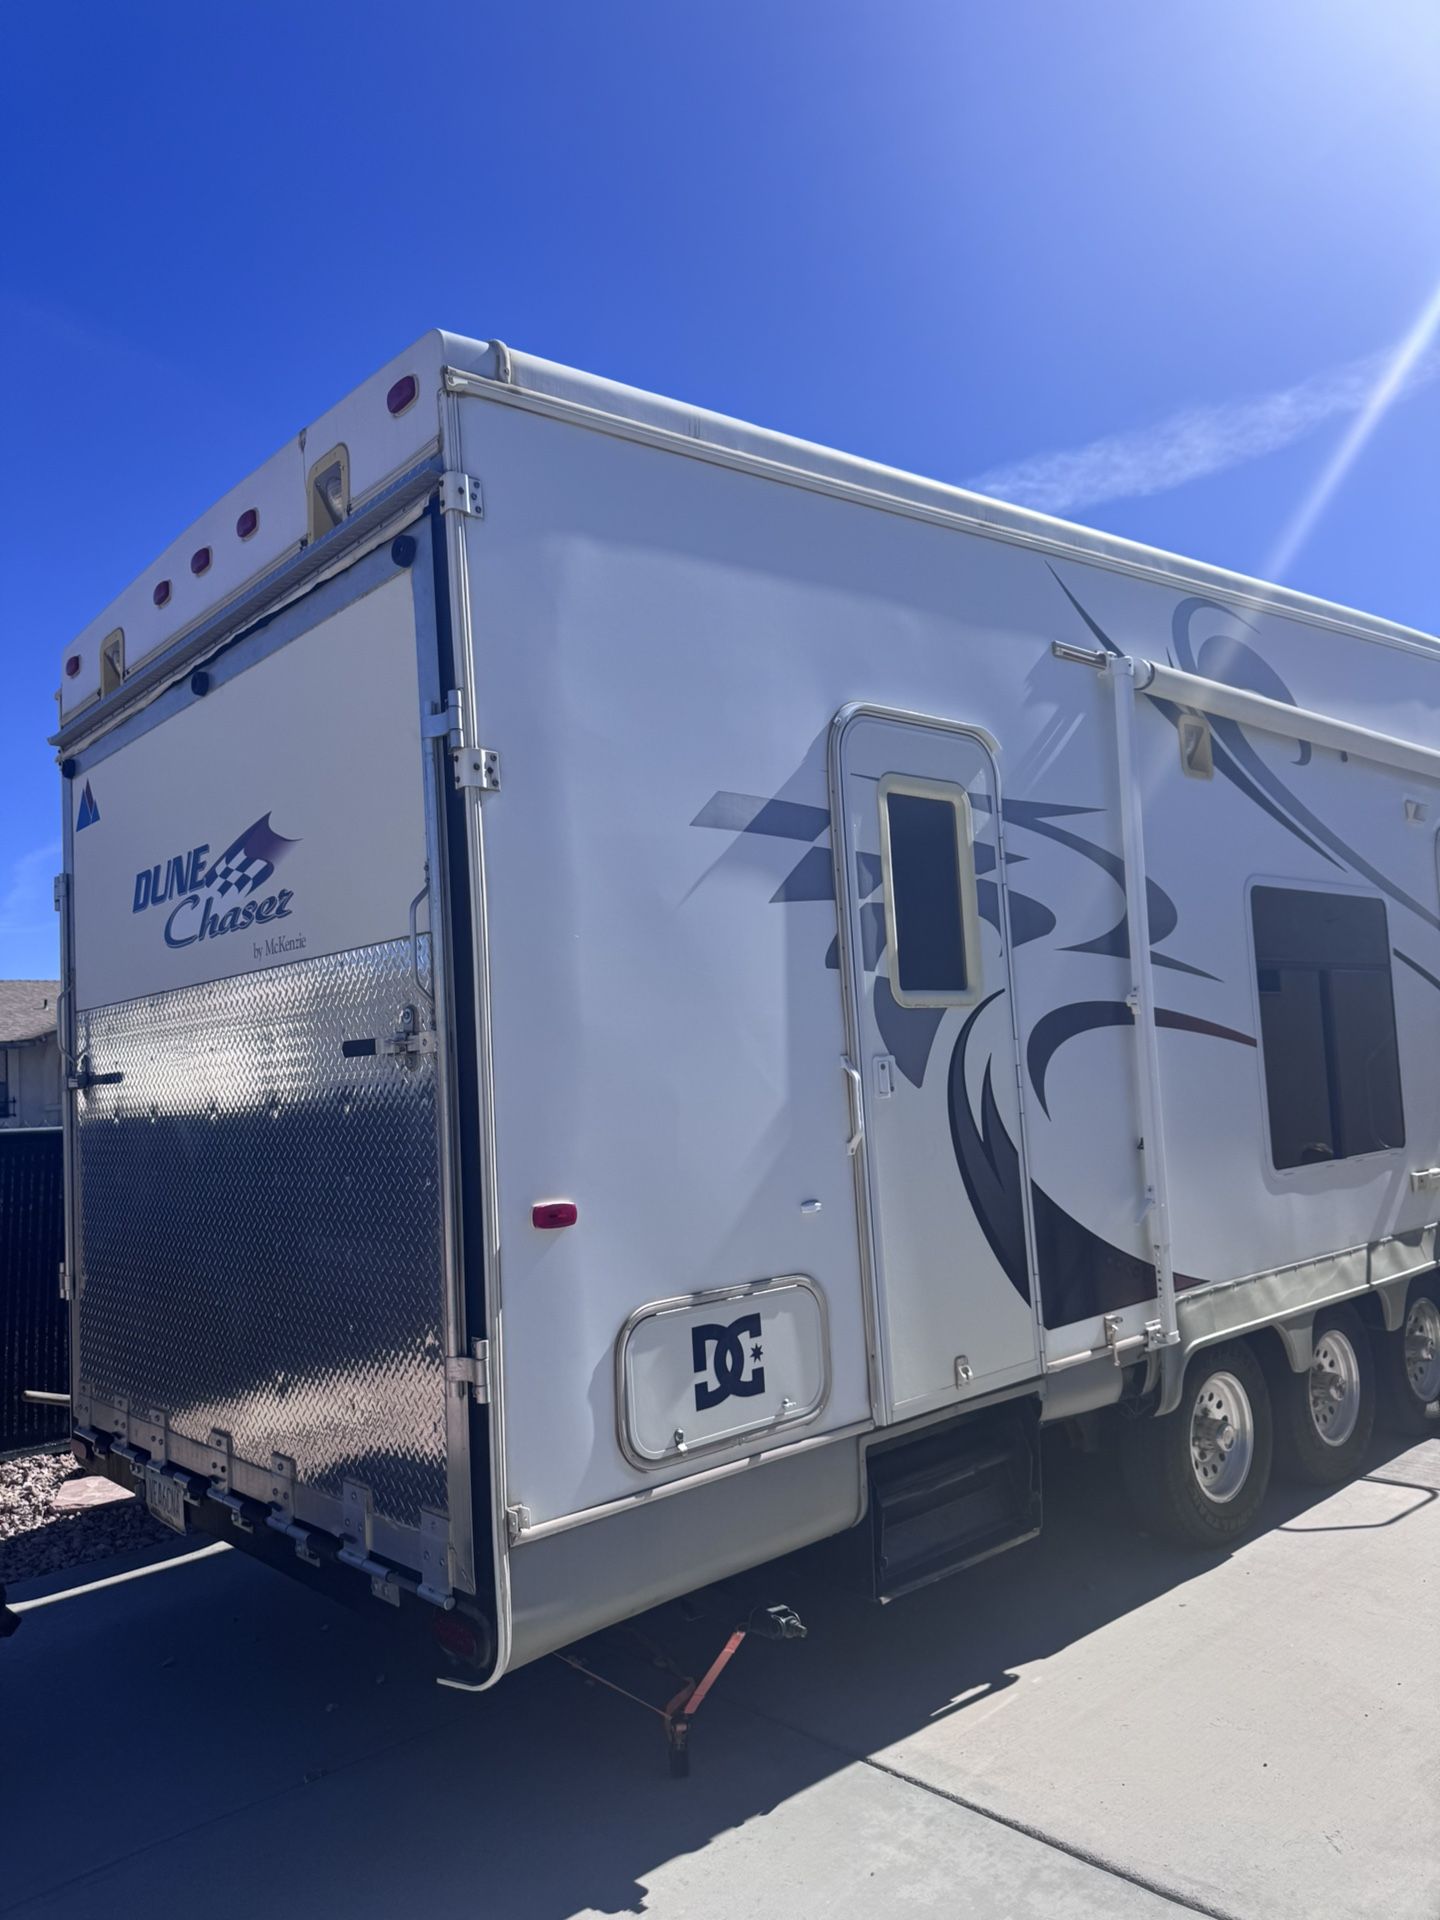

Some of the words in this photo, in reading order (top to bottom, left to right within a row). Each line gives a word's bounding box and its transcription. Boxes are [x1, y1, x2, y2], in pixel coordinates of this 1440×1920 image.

[132, 843, 210, 914] DUNE
[164, 888, 294, 949] Chaser
[253, 942, 263, 961] by
[265, 932, 307, 956] McKenzie
[691, 1312, 765, 1412] DC
